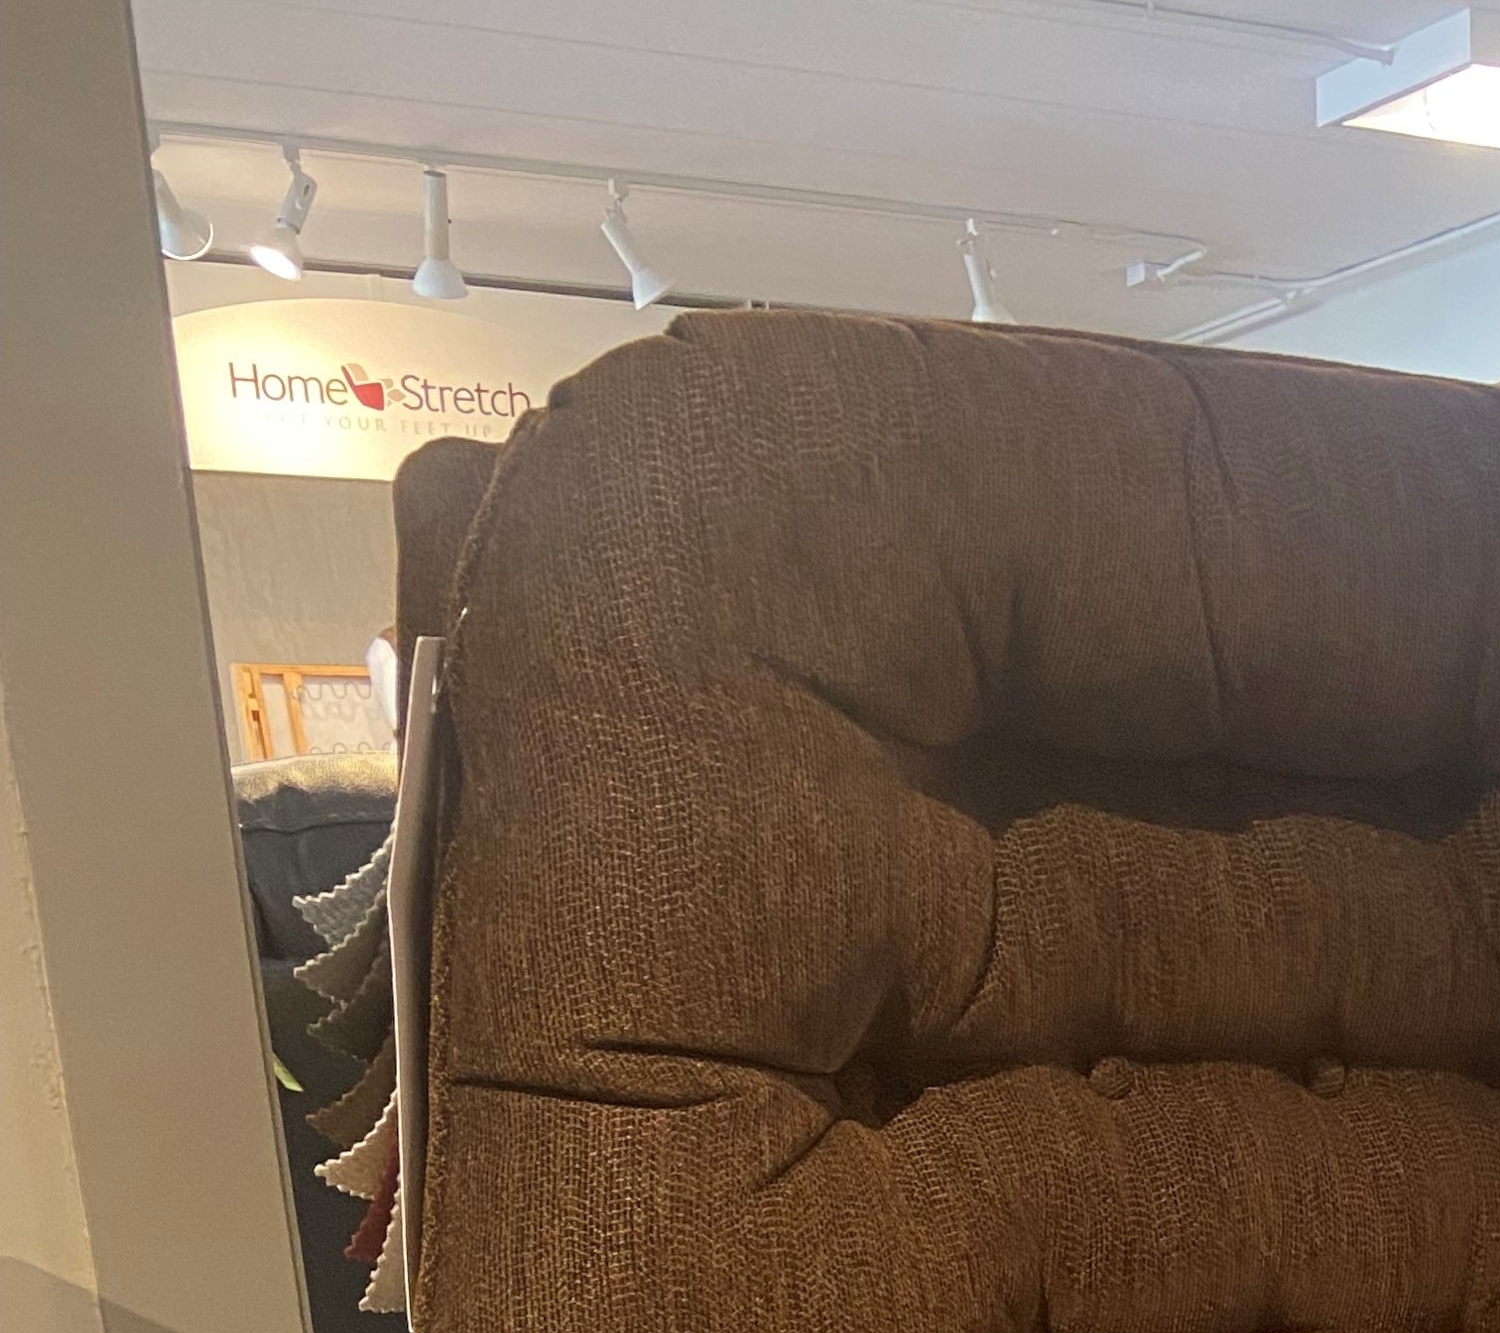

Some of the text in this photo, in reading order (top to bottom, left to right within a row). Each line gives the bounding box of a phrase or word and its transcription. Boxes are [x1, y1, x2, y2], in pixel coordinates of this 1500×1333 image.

[228, 361, 531, 418] Home Stretch
[324, 414, 387, 432] YOUR
[401, 419, 452, 435] FEET
[465, 423, 492, 439] UP
